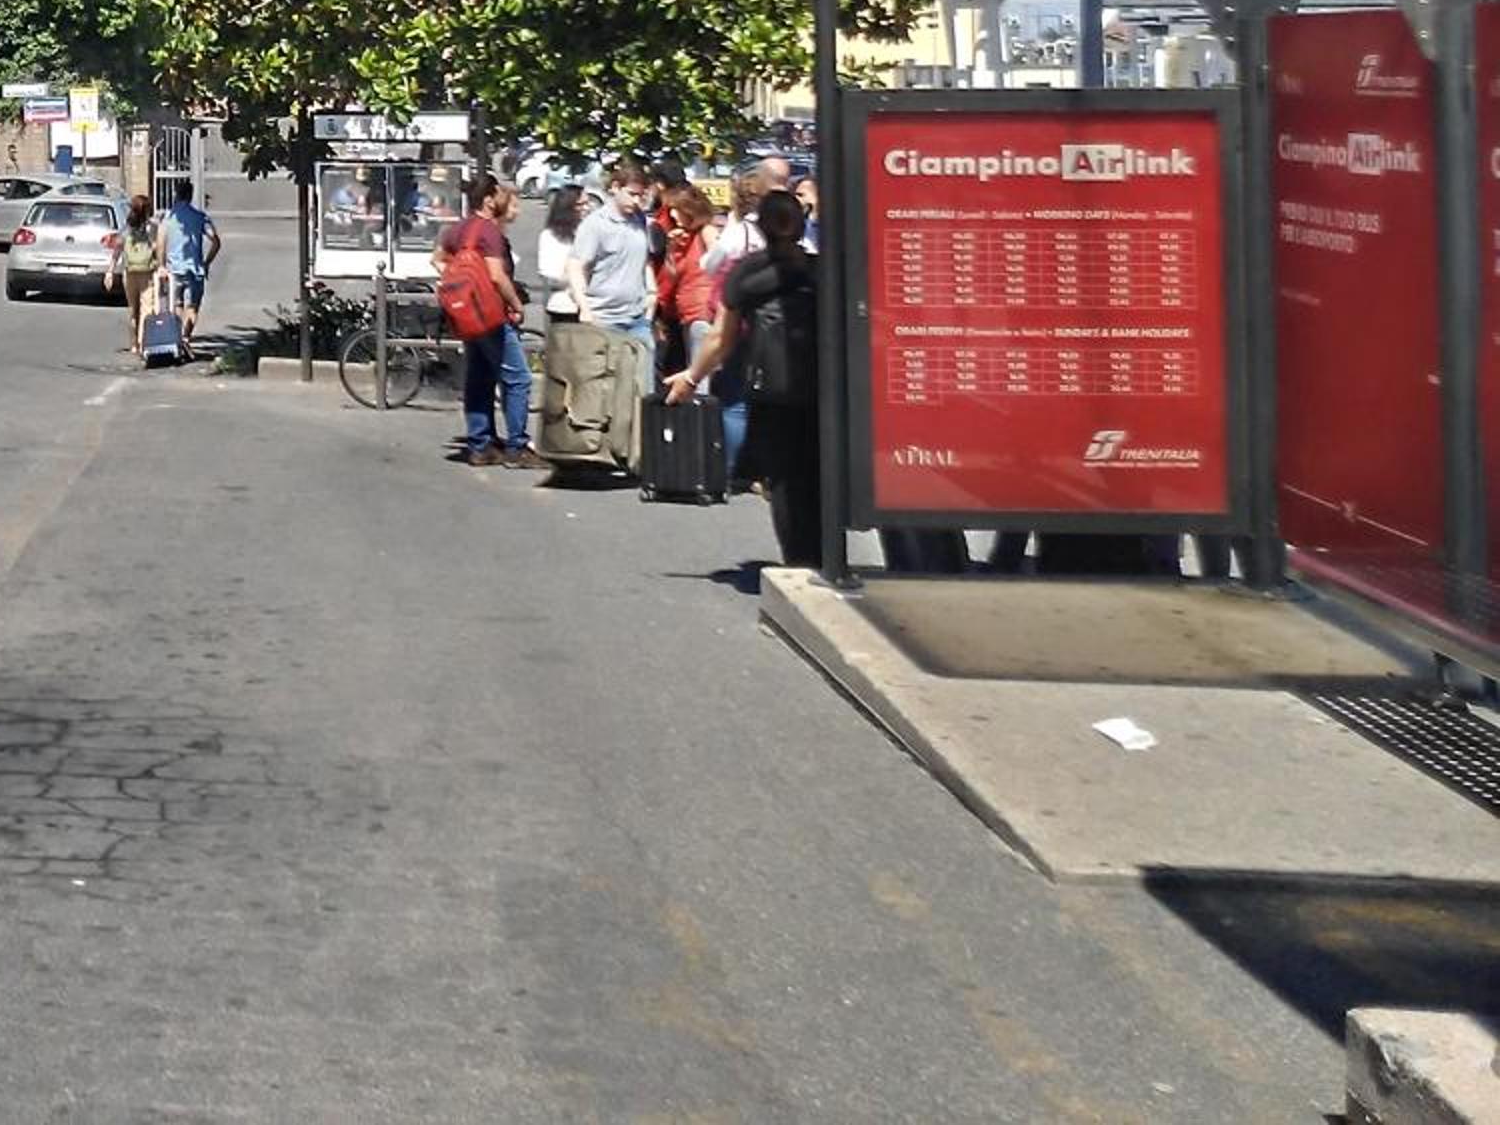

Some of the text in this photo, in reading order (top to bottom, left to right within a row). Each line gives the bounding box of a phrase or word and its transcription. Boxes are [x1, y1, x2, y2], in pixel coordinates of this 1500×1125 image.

[883, 145, 1197, 182] Ciampino Airlink
[1279, 132, 1348, 169] Ciampino
[1119, 449, 1200, 460] TRENITALIA
